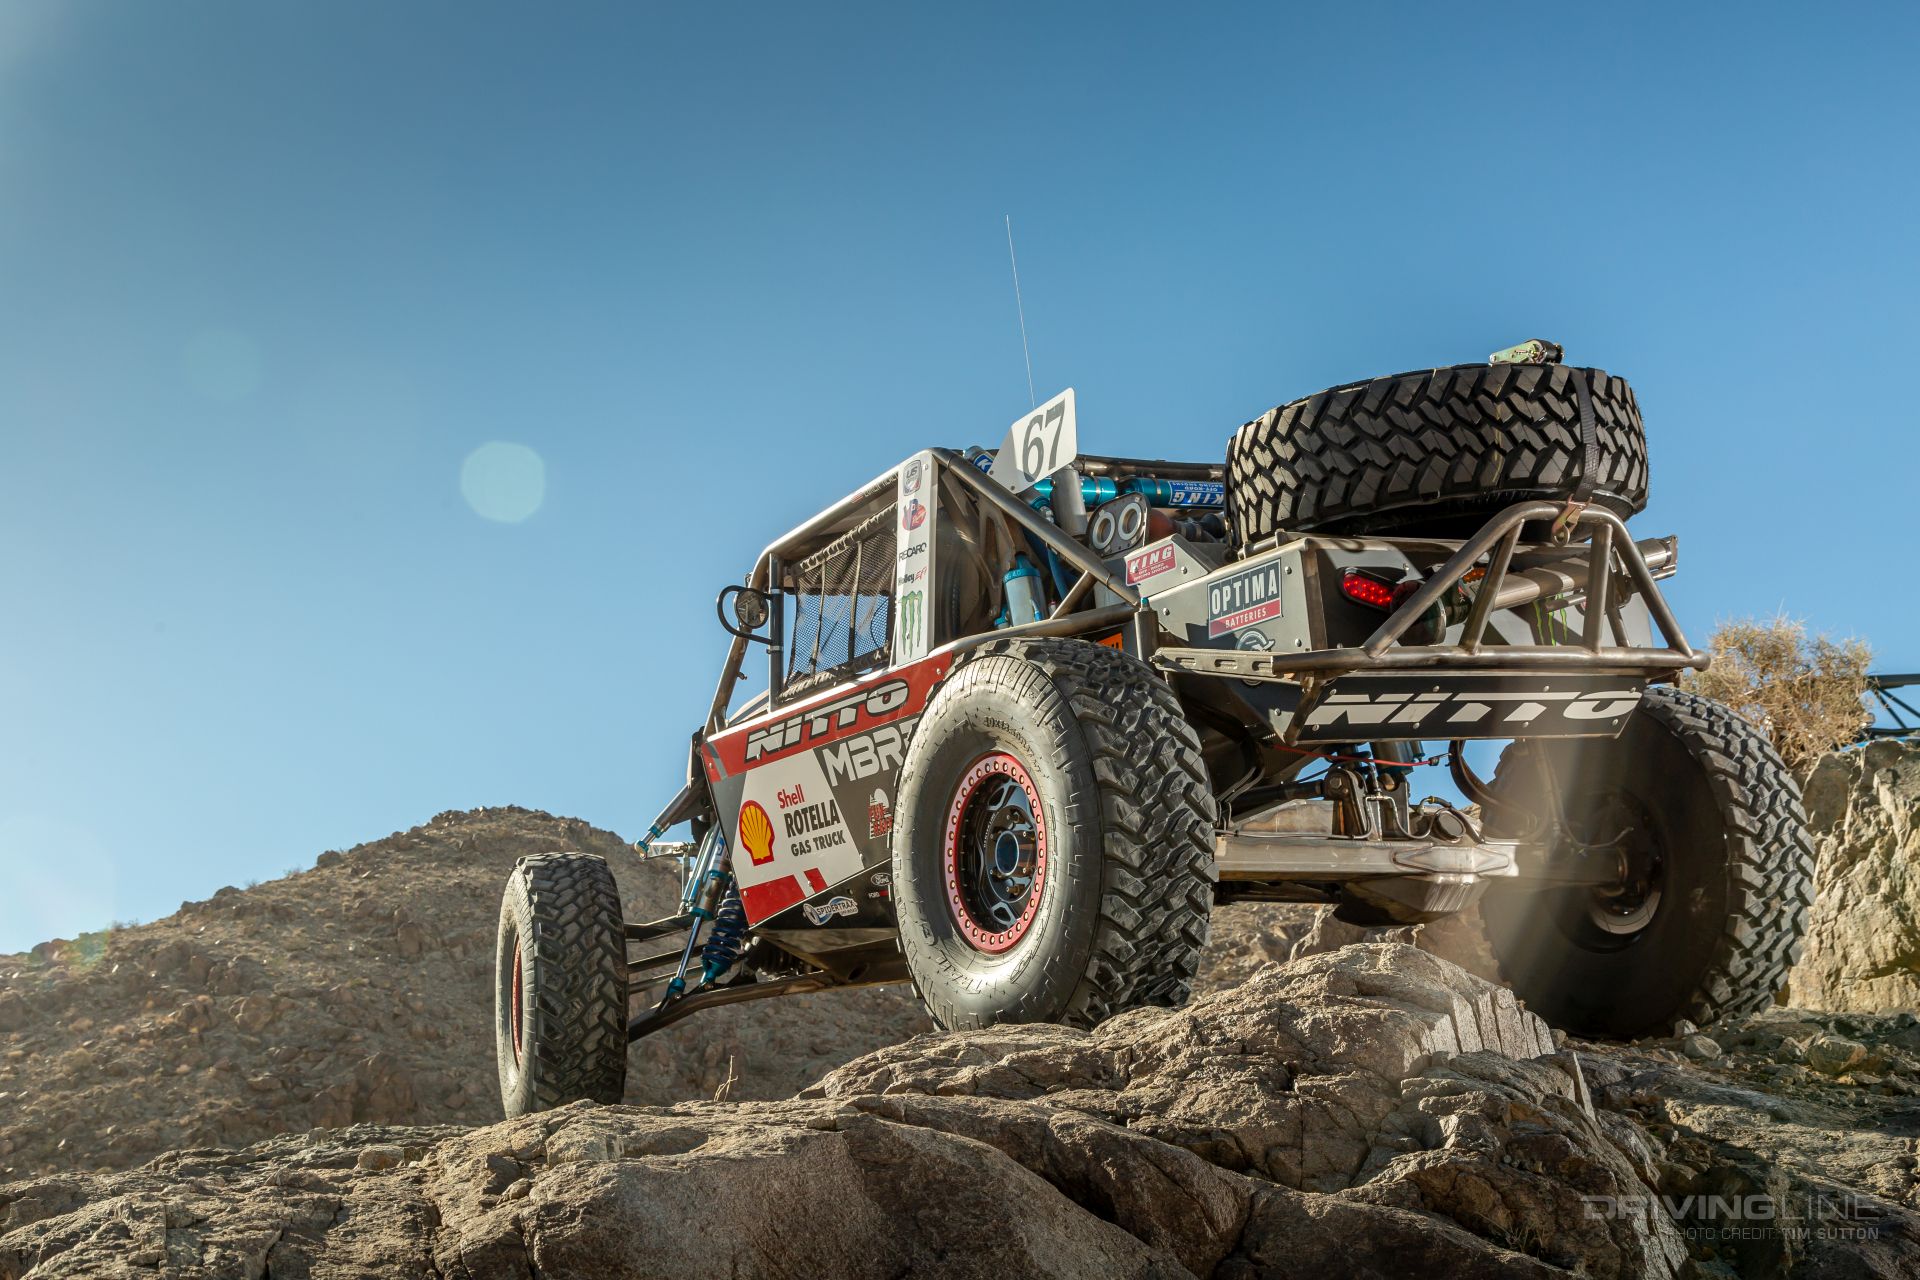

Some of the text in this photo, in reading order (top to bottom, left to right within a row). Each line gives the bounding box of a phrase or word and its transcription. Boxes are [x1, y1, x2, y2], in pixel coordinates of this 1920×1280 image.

[1022, 398, 1065, 483] 67
[1173, 491, 1224, 505] KING
[898, 542, 927, 562] RECARO
[1130, 546, 1173, 574] KING
[1211, 568, 1278, 615] OPTIMA
[1225, 607, 1268, 629] BATTERIES
[744, 679, 909, 763] NITTO
[1303, 690, 1642, 725] NITTO
[777, 783, 805, 810] Shell
[783, 799, 841, 838] ROTELLA
[790, 829, 847, 857] GAS TRUCK
[875, 874, 890, 885] Ford
[816, 899, 856, 916] SPIDERTRAX
